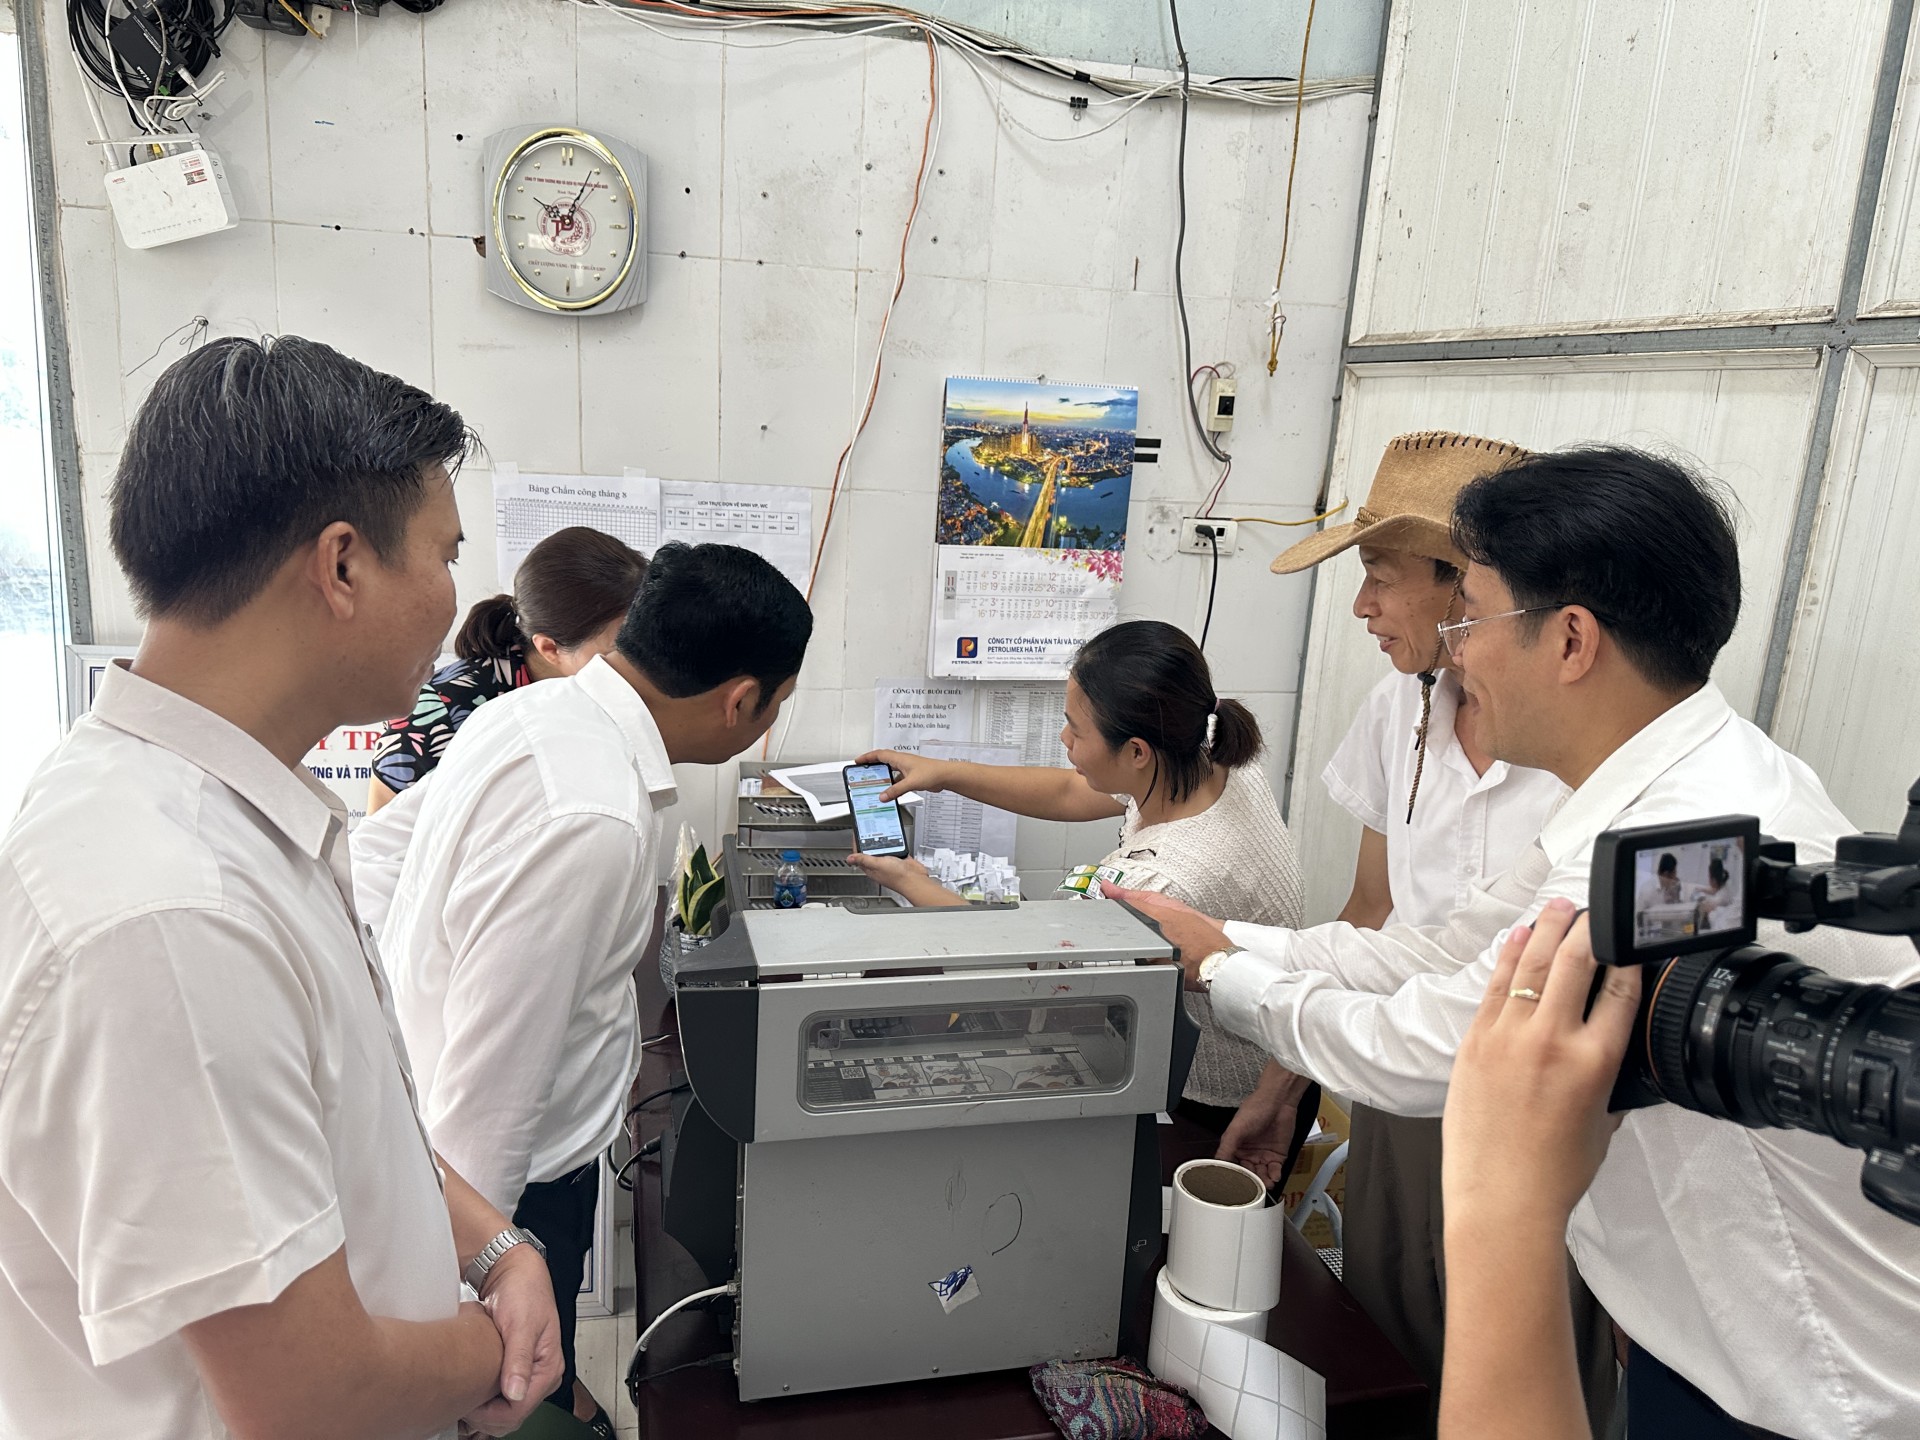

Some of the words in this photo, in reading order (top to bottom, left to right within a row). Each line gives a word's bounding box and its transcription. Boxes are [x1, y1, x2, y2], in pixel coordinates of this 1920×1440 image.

[529, 484, 549, 495] Bảng
[577, 488, 596, 498] công
[598, 490, 620, 500] tháng
[992, 571, 998, 580] 5
[1049, 572, 1056, 581] 12
[991, 582, 998, 590] 19
[991, 598, 996, 606] 3
[1046, 599, 1054, 607] 10
[1014, 636, 1022, 644] CỔ
[1064, 637, 1072, 645] VÀ
